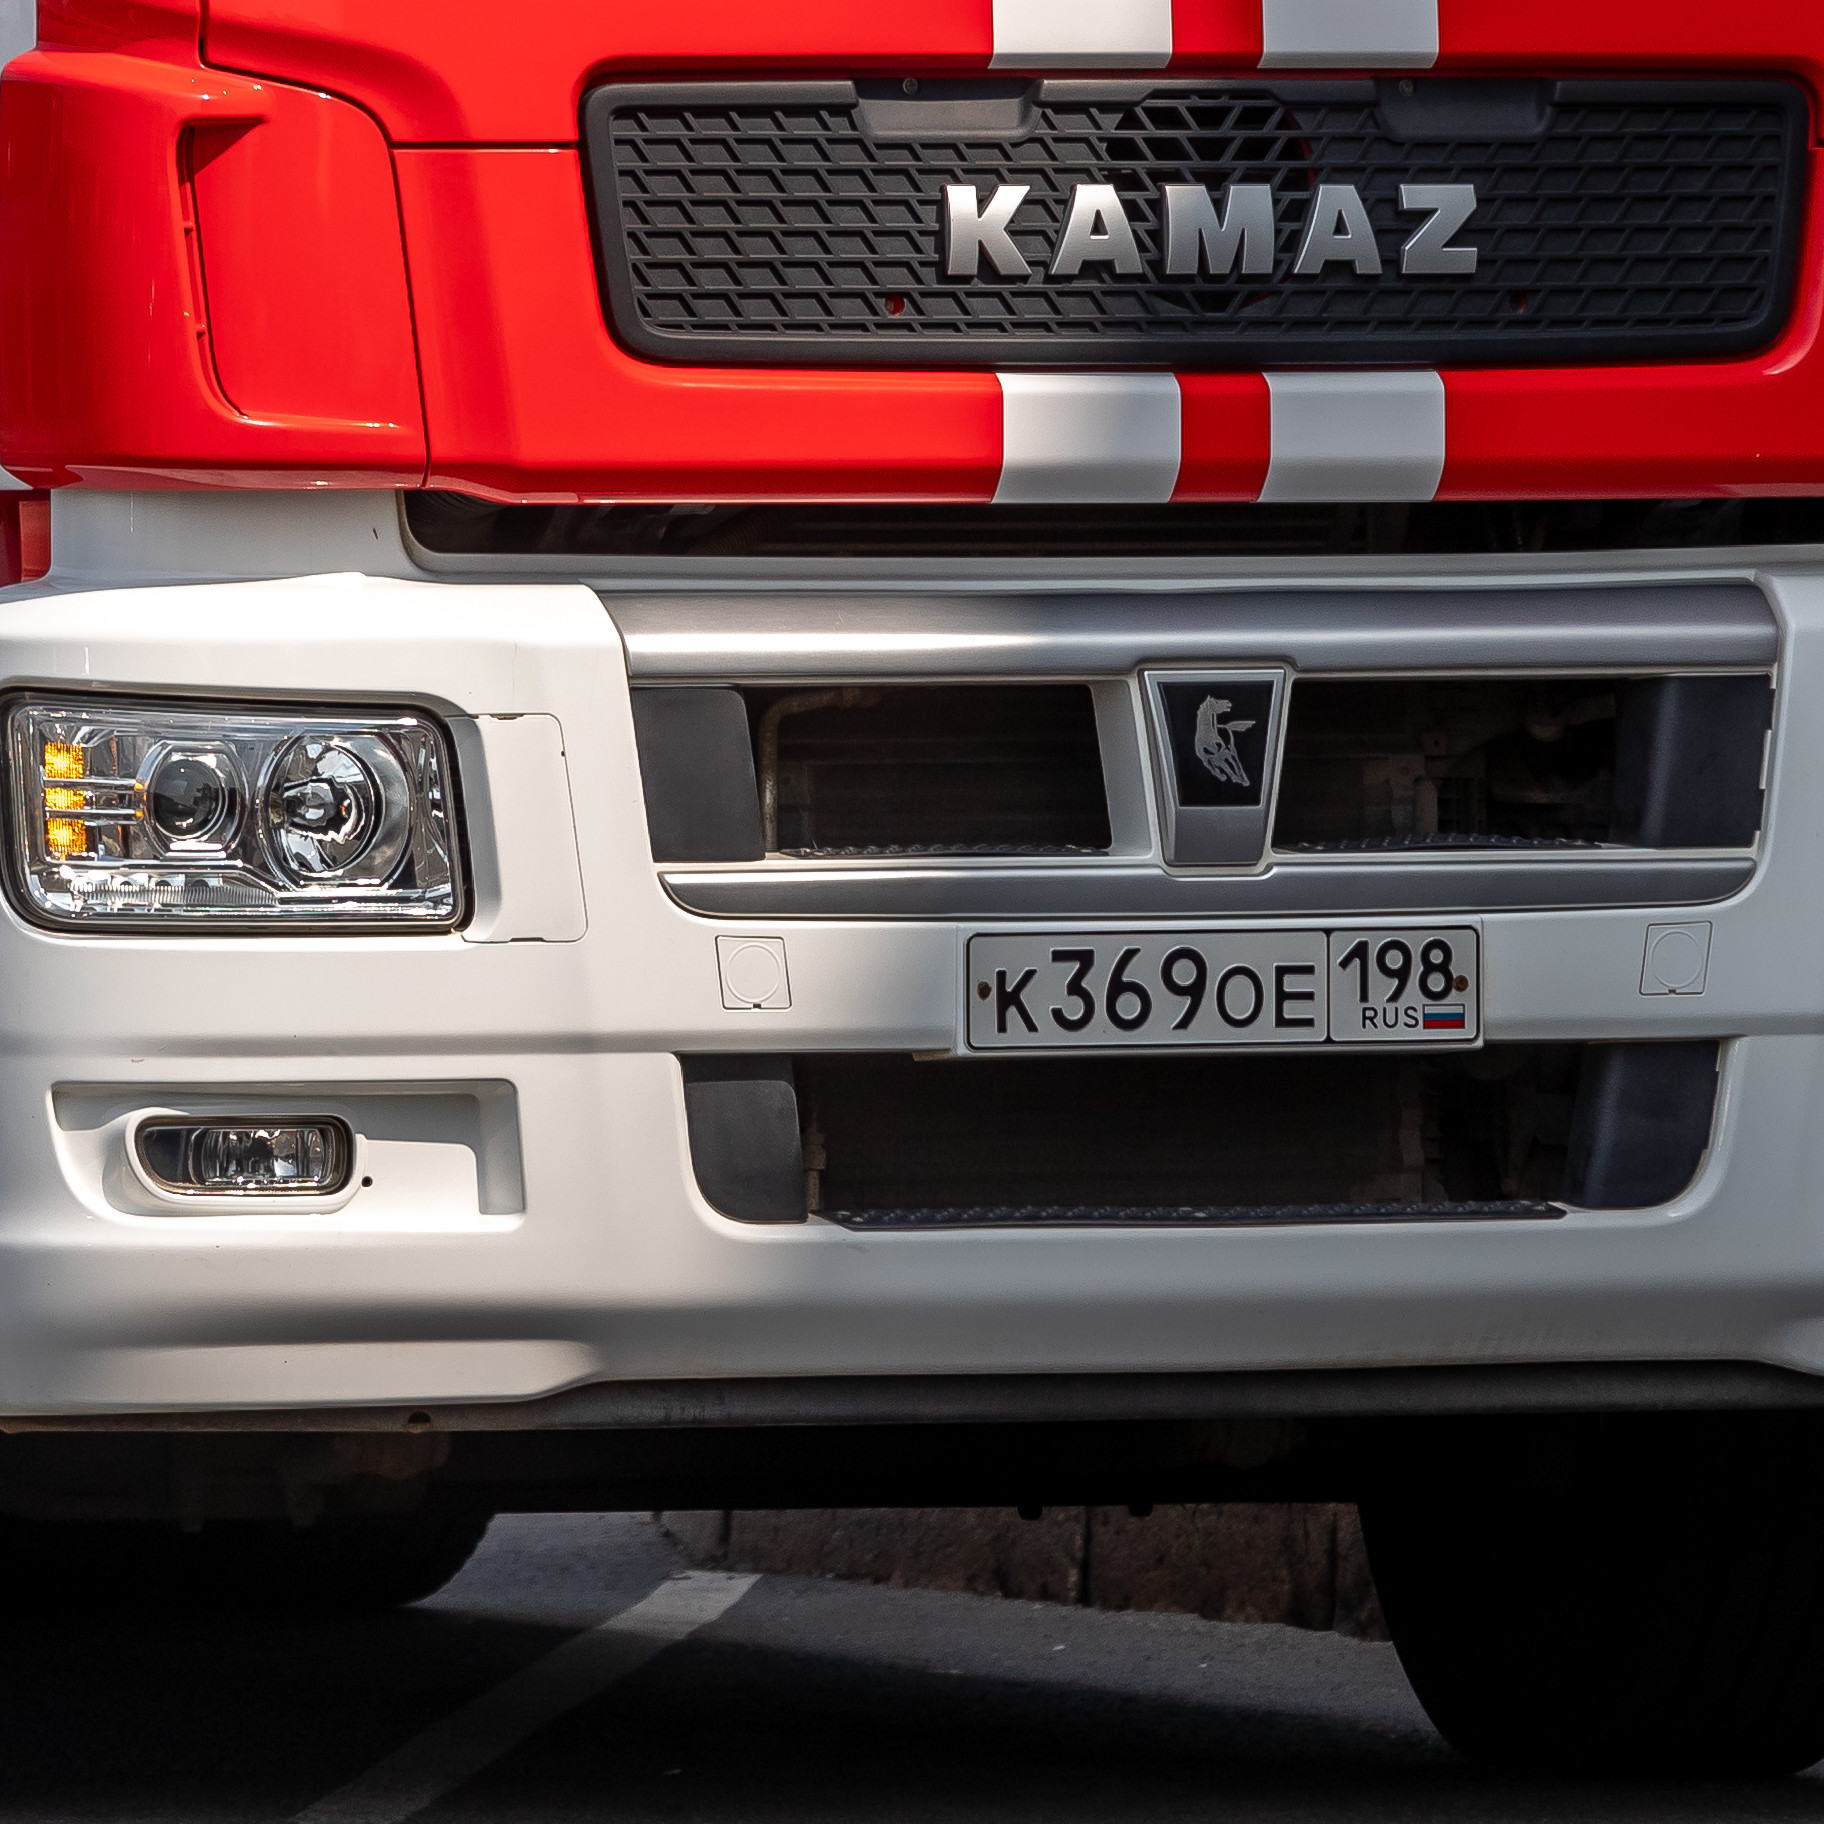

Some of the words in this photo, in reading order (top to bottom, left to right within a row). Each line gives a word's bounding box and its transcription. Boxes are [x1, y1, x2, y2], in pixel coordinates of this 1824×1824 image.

[942, 183, 1477, 275] KAMAZ
[995, 944, 1316, 1034] К369ОЕ
[1337, 937, 1455, 1004] 198
[1362, 1005, 1420, 1030] RUS
